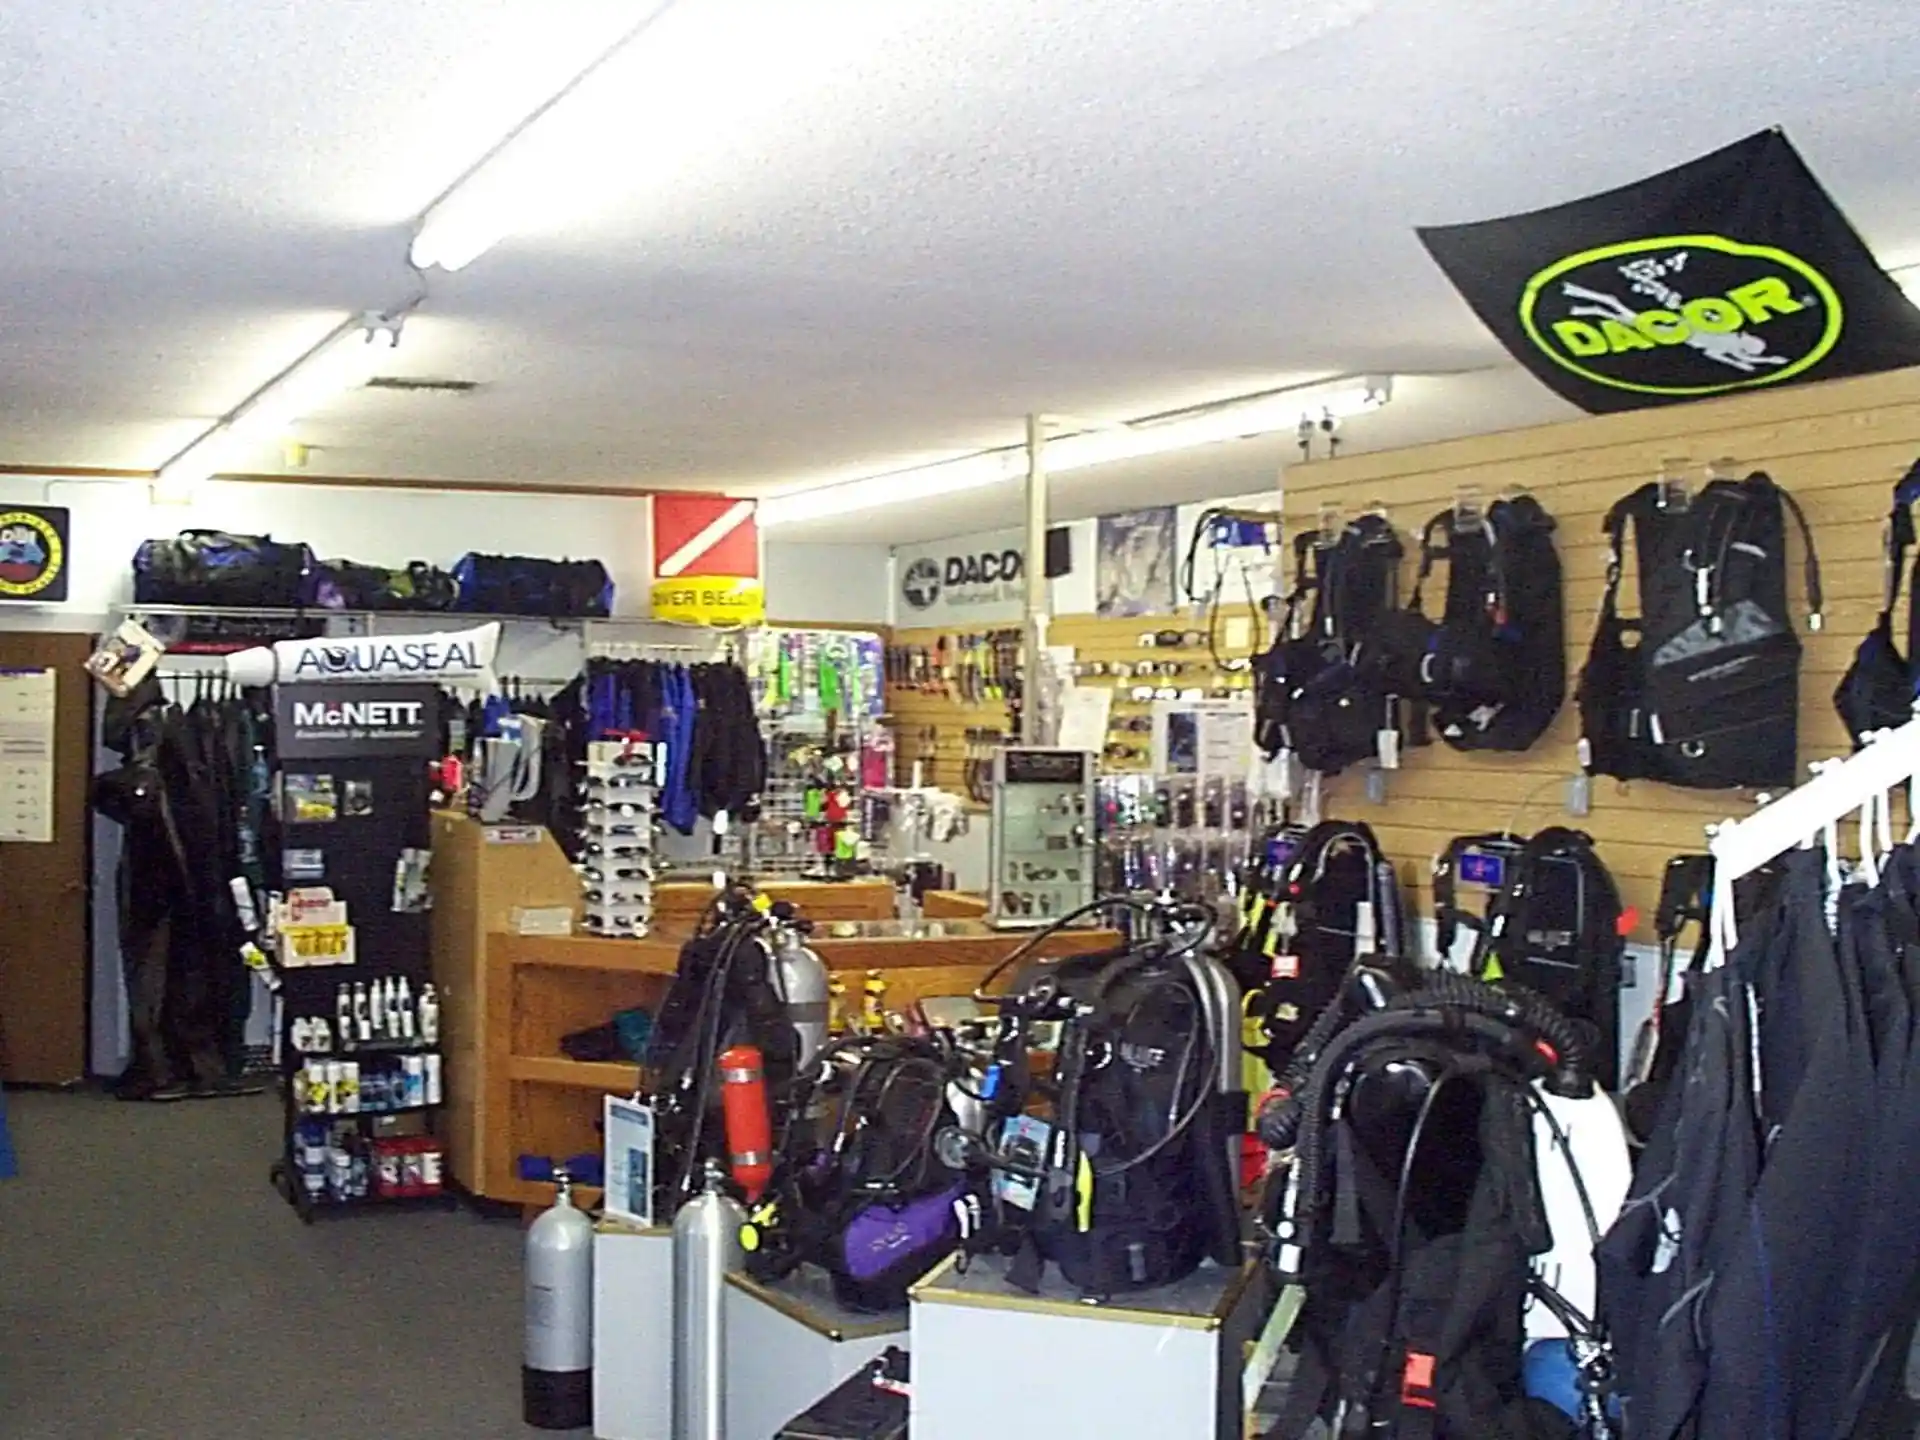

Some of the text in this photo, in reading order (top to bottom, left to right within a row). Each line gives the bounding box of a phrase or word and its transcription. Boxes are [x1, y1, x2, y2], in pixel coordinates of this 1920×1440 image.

[1552, 277, 1804, 356] DACOR
[945, 550, 1026, 586] DACO
[295, 642, 483, 675] AQUASEAL
[294, 702, 423, 725] McNETT
